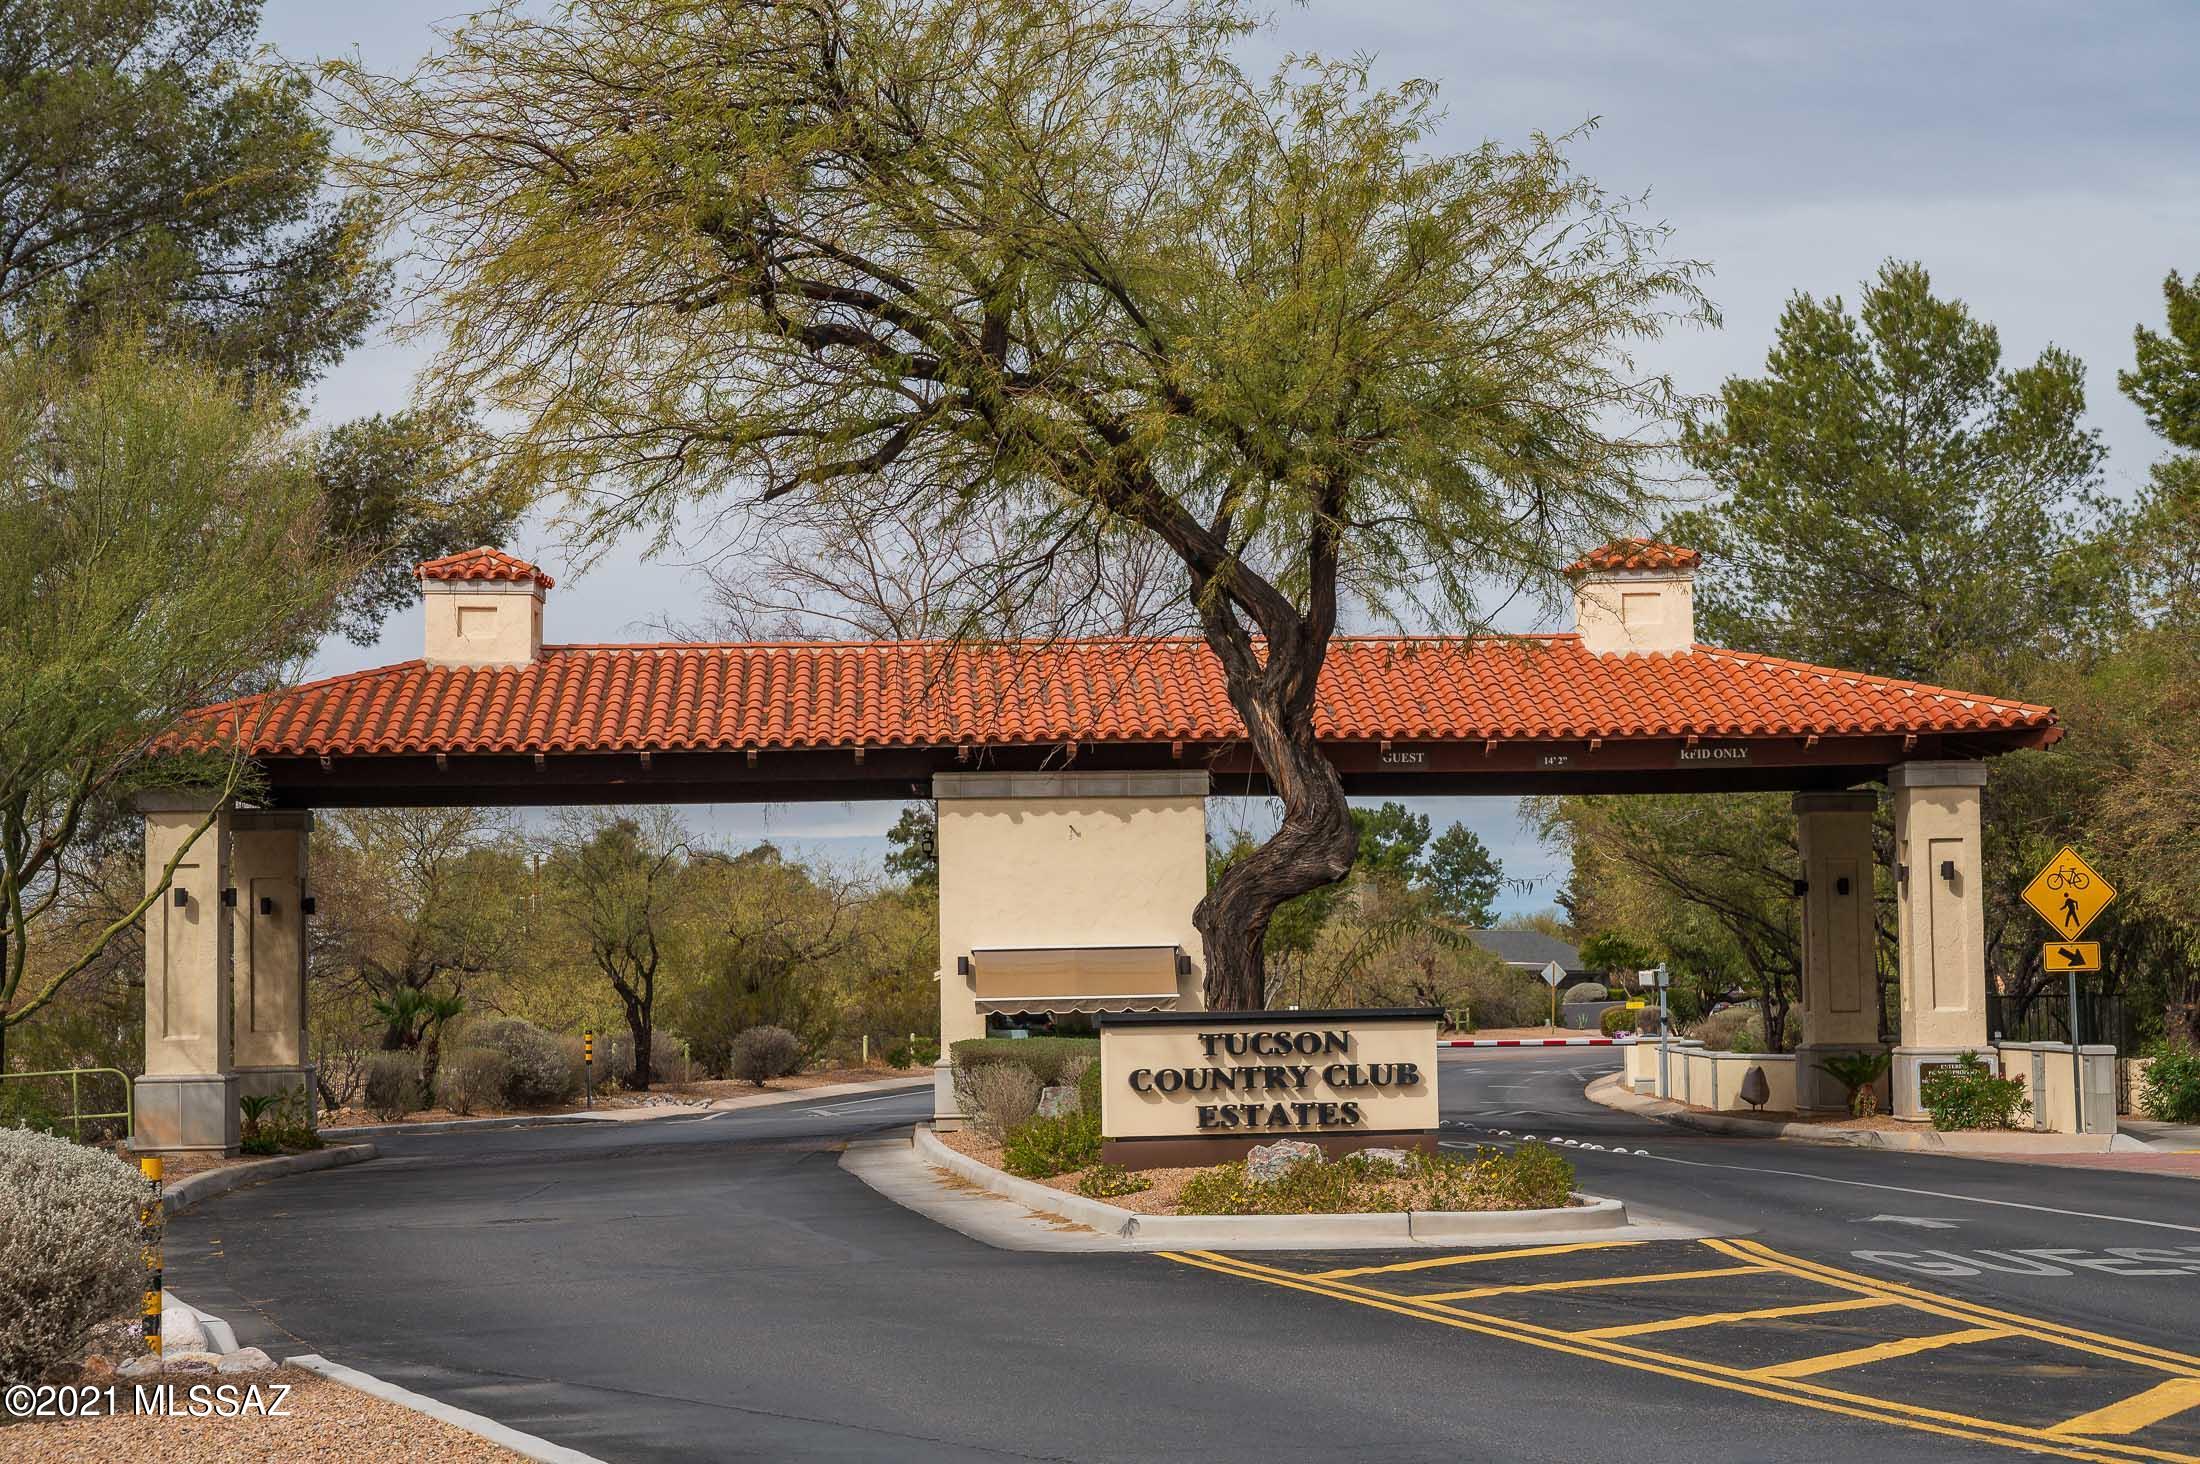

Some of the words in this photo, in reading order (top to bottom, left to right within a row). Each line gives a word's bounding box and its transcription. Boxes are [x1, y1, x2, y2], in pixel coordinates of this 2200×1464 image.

[1382, 752, 1425, 763] GUEST
[1713, 747, 1749, 759] ONLY
[1198, 1030, 1350, 1057] TUCSON
[1128, 1064, 1314, 1093] COUNTRY
[1322, 1062, 1420, 1088] CLUB
[1196, 1101, 1361, 1130] ESTATES
[1851, 1246, 2200, 1276] GUES
